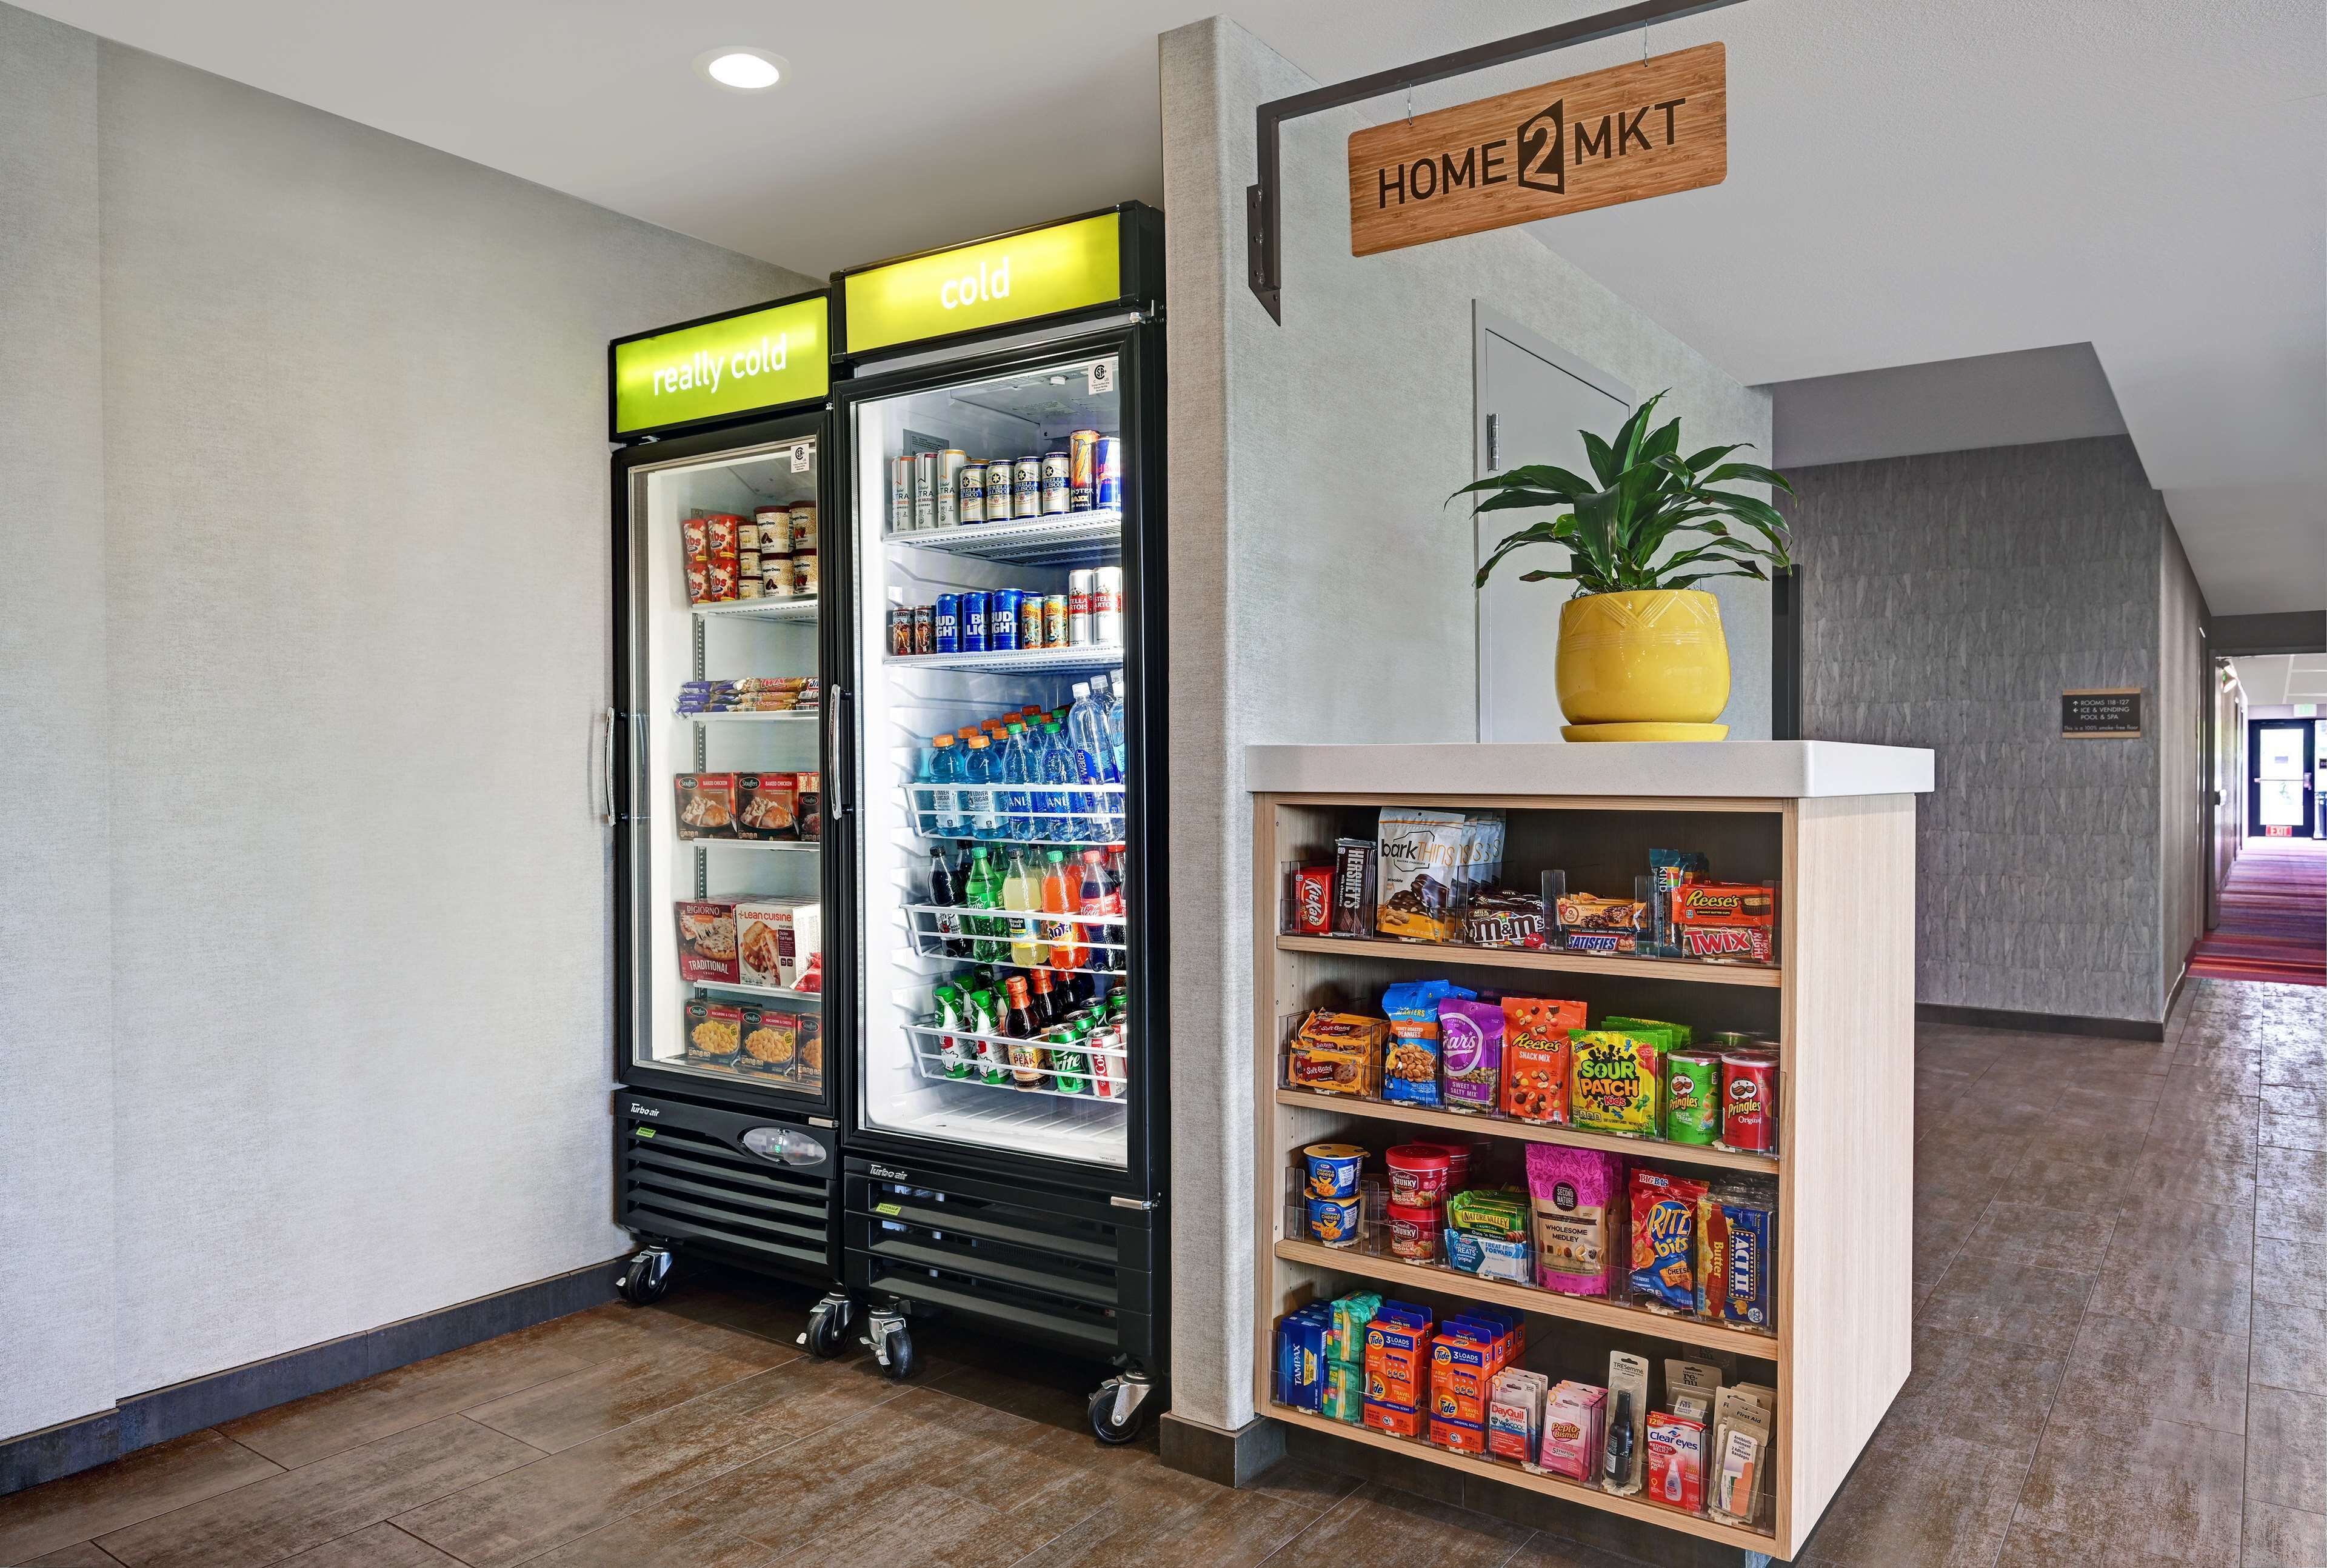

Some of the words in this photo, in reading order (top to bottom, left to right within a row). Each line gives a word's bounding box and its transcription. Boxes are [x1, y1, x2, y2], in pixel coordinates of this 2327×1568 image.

[1379, 139, 1507, 209] HOME
[1520, 108, 1563, 189] 2
[1575, 97, 1686, 165] MKT
[941, 256, 1010, 309] cold
[653, 353, 724, 396] really
[730, 332, 787, 379] cold
[1658, 866, 1668, 892] KIND
[1048, 922, 1072, 940] anta
[1567, 936, 1617, 950] SATISFIES
[688, 959, 729, 975] TRADITIONAL
[1013, 1056, 1035, 1065] PEAK
[1518, 1051, 1538, 1061] SNACK
[1538, 1053, 1551, 1063] MIX
[1318, 1065, 1333, 1073] Batch
[1581, 1061, 1637, 1080] SOUR
[1452, 1081, 1469, 1090] SWEET
[1580, 1078, 1640, 1098] PATCH
[1604, 1096, 1626, 1107] Kids
[1669, 1097, 1699, 1113] Pringles
[630, 1103, 650, 1115] Turbo
[1728, 1100, 1761, 1119] Pringles
[1738, 1116, 1762, 1124] Original
[870, 1164, 894, 1178] Turbo
[894, 1170, 908, 1180] air
[1393, 1176, 1416, 1188] CHUNKY
[1639, 1173, 1654, 1183] BIG
[1654, 1176, 1669, 1187] BAG
[1557, 1188, 1574, 1198] SECOND
[1557, 1196, 1574, 1206] NATURE
[1464, 1212, 1487, 1223] NATURE
[1487, 1215, 1509, 1228] VALLEY
[1648, 1204, 1692, 1239] RITZ
[1393, 1225, 1416, 1238] CHUNKY
[1545, 1224, 1588, 1236] WHOLESOME
[1552, 1233, 1579, 1243] MEDLEY
[1456, 1246, 1476, 1256] TREATS
[1485, 1247, 1512, 1257] FORWARD
[1654, 1236, 1688, 1258] bits
[1713, 1241, 1724, 1279] Butter
[1735, 1236, 1749, 1272] ACT
[1735, 1272, 1749, 1292] II
[1369, 1335, 1383, 1345] Tide
[1386, 1335, 1391, 1344] 3
[1391, 1337, 1409, 1346] LOADS
[1435, 1350, 1450, 1360] Tide
[1453, 1351, 1458, 1359] 3
[1458, 1353, 1478, 1361] LOADS
[1485, 1353, 1489, 1361] 3
[1293, 1343, 1301, 1386] TAMPAX
[1394, 1390, 1411, 1398] TRAVEL
[1440, 1400, 1456, 1413] Tide
[1461, 1406, 1480, 1415] TRAVEL
[1491, 1404, 1524, 1420] DayQuil
[1736, 1410, 1750, 1420] First
[1554, 1431, 1579, 1440] Bismol
[1650, 1431, 1675, 1444] Clear
[1734, 1435, 1752, 1446] Antibiotic
[1649, 1442, 1673, 1452] REDNESS
[1733, 1440, 1751, 1449] Ointment
[1556, 1448, 1575, 1456] SYMPTOM
[1731, 1450, 1749, 1461] Bandages
[1734, 1447, 1751, 1456] Adhesive
